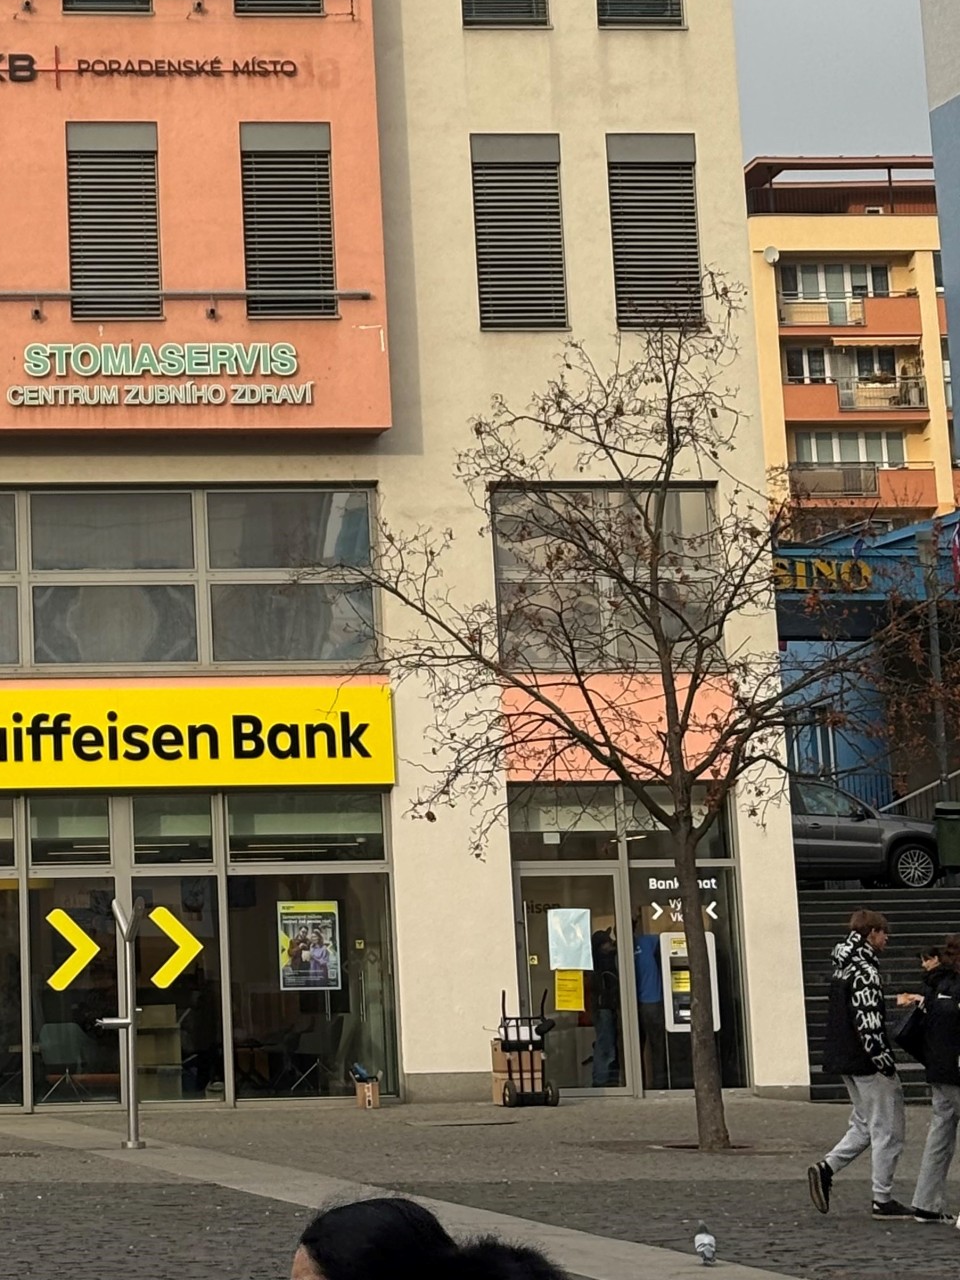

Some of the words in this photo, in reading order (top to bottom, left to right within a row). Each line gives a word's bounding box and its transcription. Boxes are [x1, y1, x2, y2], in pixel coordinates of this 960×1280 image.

[77, 56, 223, 78] PORADENSKÉ
[232, 56, 298, 78] MÍSTO
[23, 342, 298, 377] STOMASERVIS
[6, 385, 119, 406] CENTRUM
[124, 381, 226, 405] ZUBNÍHO
[231, 381, 314, 405] ZDRAVÍ
[231, 711, 372, 760] Bank
[648, 876, 718, 890] Bankat
